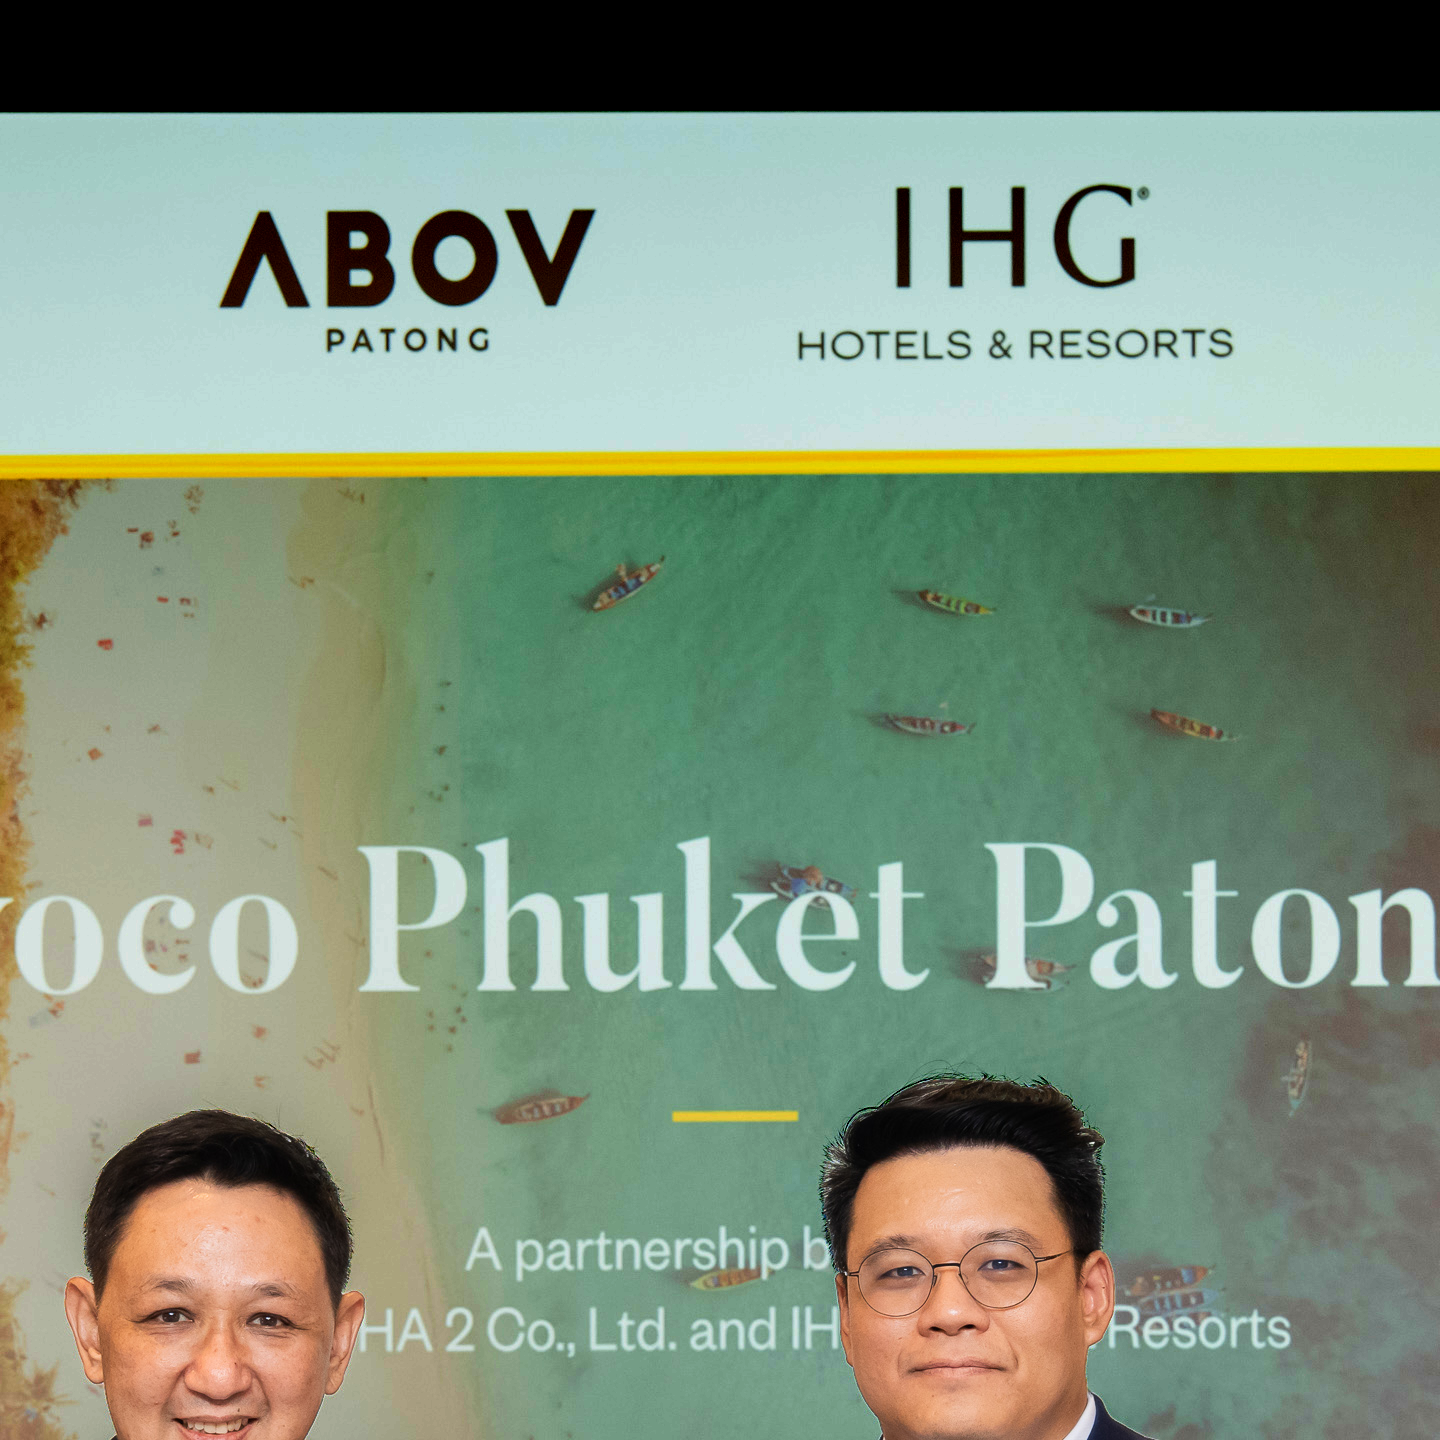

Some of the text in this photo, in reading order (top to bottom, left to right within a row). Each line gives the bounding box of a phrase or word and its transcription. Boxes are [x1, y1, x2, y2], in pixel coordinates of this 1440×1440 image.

[218, 208, 597, 309] ABOV
[894, 182, 1137, 290] IHG
[325, 327, 490, 354] PATONG
[797, 327, 1235, 362] HOTELS & RESORTS
[359, 837, 930, 993] Phuket
[464, 1227, 503, 1272] A
[516, 1224, 790, 1282] partnership
[445, 1306, 476, 1352] 2
[487, 1306, 576, 1358] Co.,
[589, 1306, 677, 1351] Ltd.
[689, 1306, 777, 1351] and
[1109, 1304, 1293, 1350] Resorts
